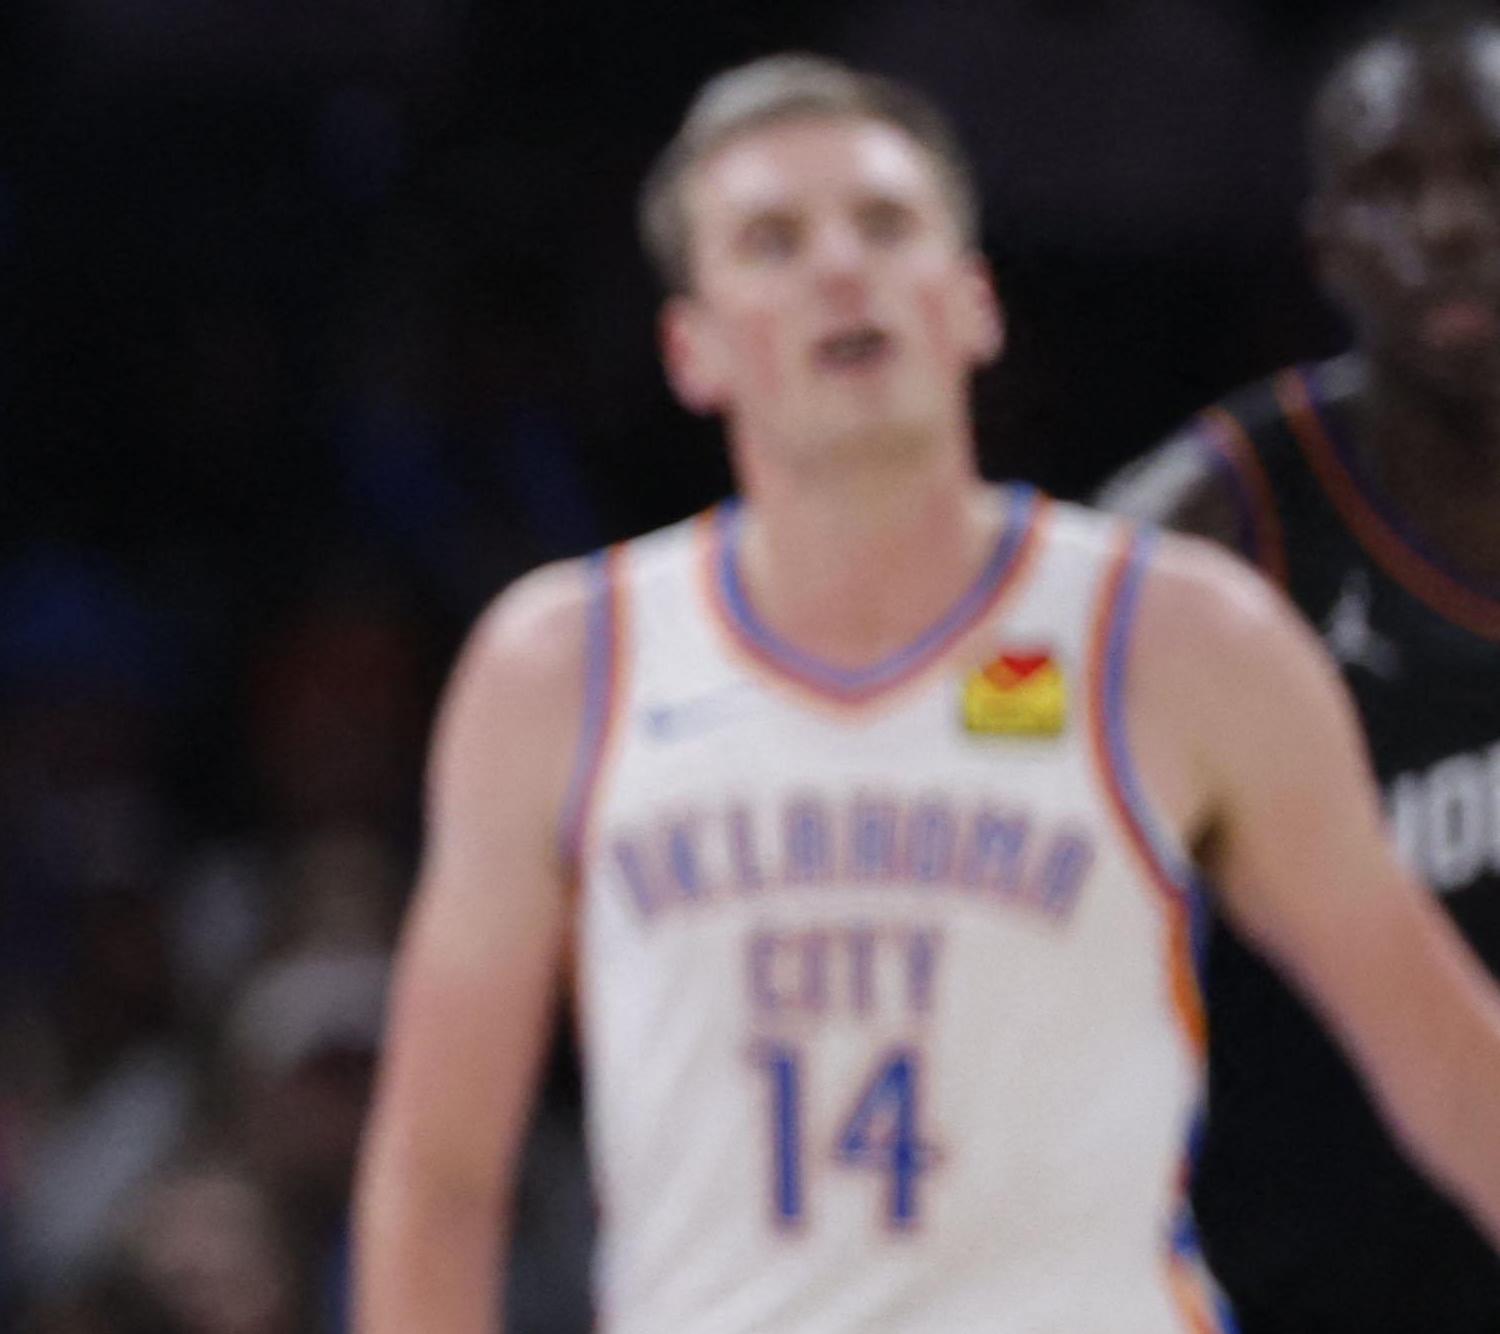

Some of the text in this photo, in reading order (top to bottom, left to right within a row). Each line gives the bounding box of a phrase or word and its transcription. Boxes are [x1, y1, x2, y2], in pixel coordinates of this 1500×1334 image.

[610, 789, 1100, 927] OKLAHOMA
[742, 919, 945, 1017] CITY
[743, 1037, 953, 1237] 14
